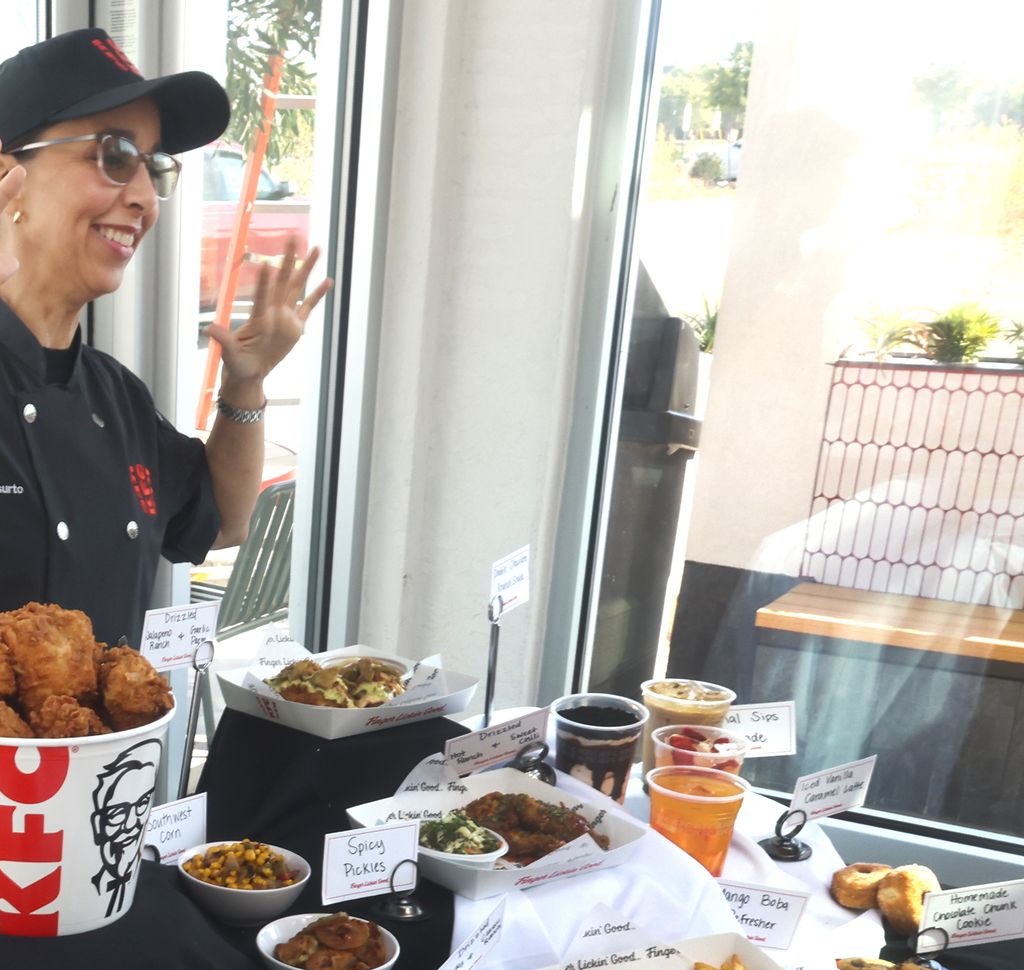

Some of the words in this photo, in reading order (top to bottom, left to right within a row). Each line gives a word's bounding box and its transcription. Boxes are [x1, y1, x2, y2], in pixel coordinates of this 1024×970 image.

[165, 610, 196, 623] Drizzled
[751, 711, 779, 722] Sips
[160, 828, 181, 843] Corn
[348, 836, 385, 856] Spicy
[344, 861, 386, 877] Pickles
[761, 894, 789, 911] Boba
[951, 888, 1008, 904] Homemade
[933, 907, 975, 922] Chocolate
[984, 901, 1017, 914] Chunk
[736, 912, 776, 929] fresher
[957, 918, 992, 930] Cookie
[645, 946, 678, 960] Finge
